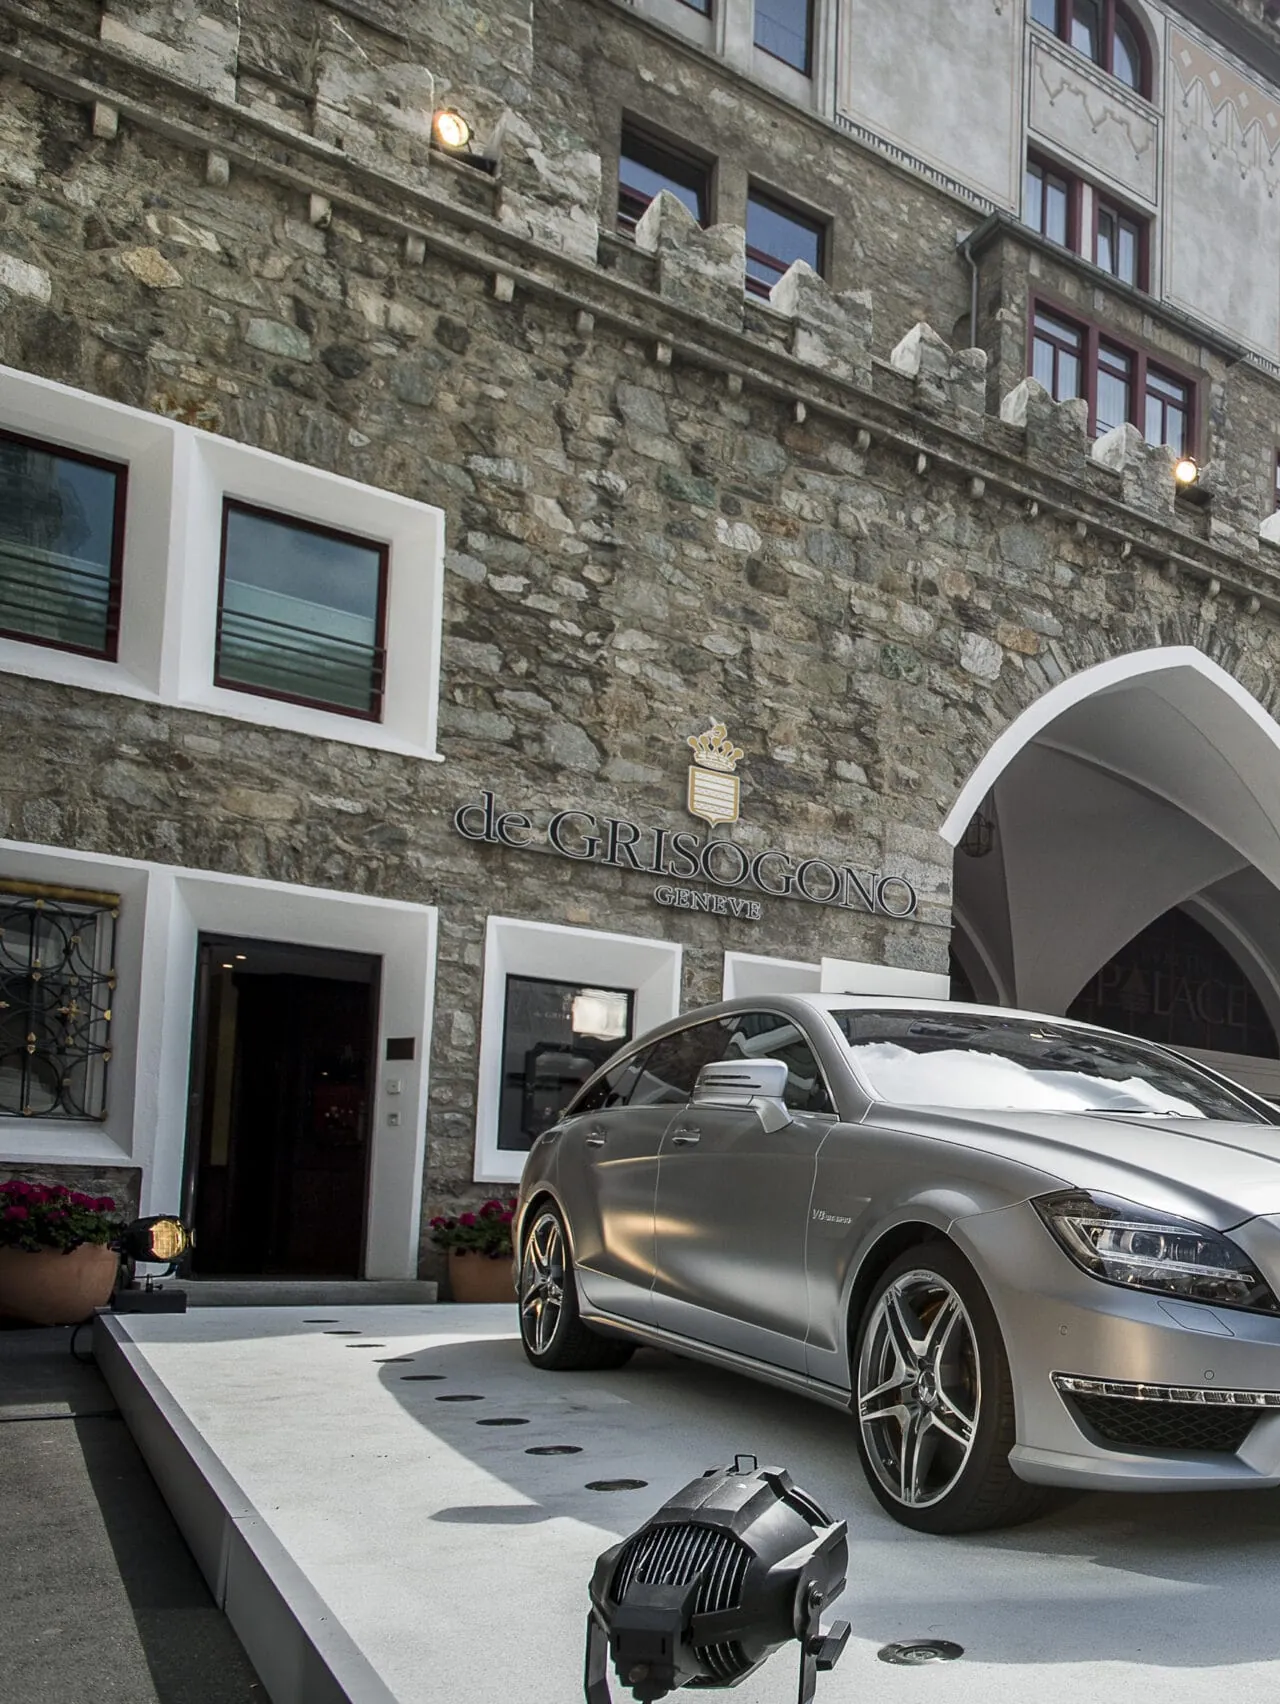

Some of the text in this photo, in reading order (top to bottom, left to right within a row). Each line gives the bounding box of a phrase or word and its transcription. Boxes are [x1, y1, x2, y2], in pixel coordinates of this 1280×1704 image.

[454, 790, 917, 918] de GRISOGONO
[653, 885, 761, 920] GENEVE
